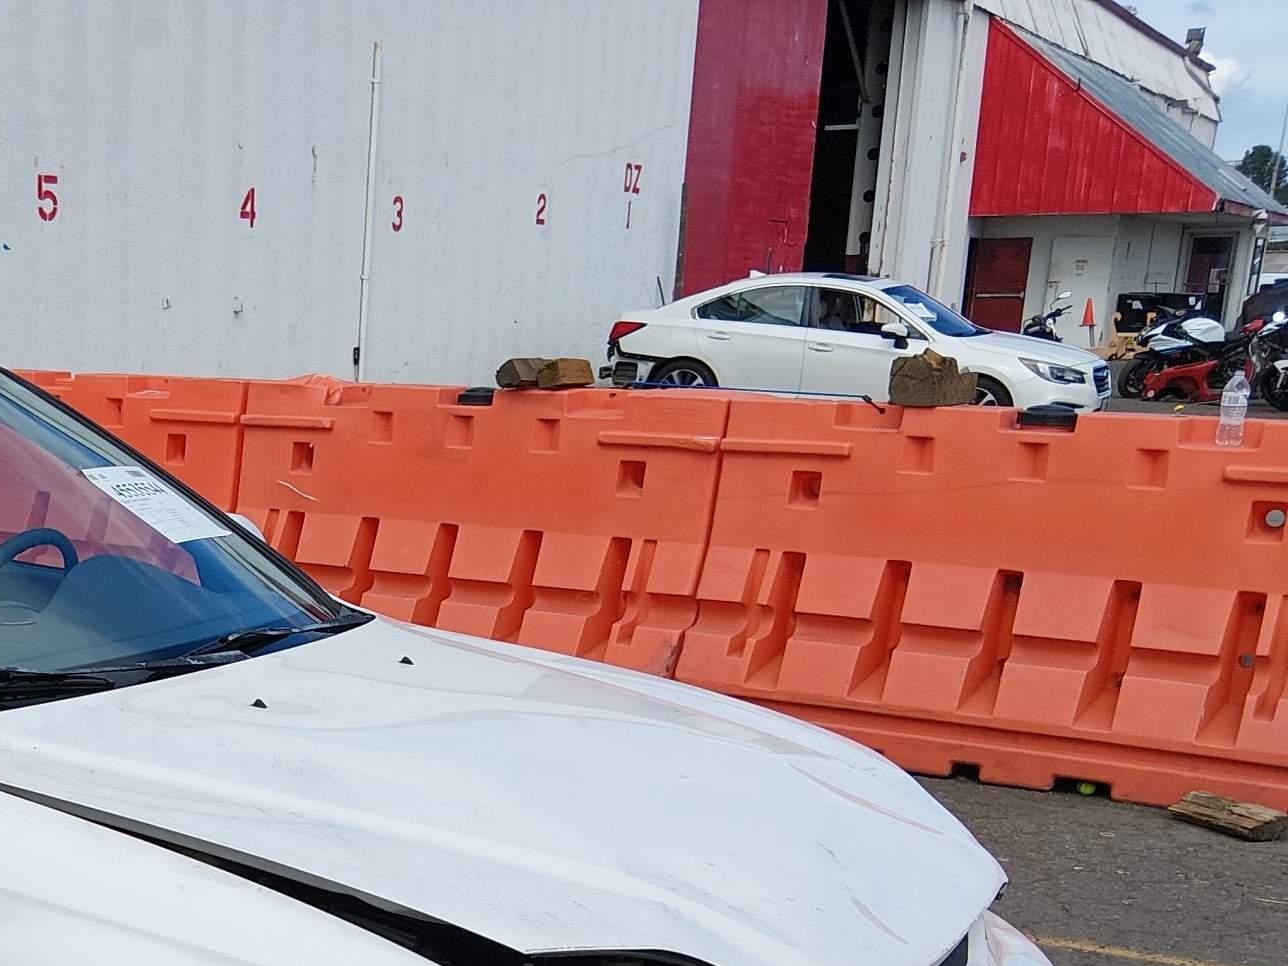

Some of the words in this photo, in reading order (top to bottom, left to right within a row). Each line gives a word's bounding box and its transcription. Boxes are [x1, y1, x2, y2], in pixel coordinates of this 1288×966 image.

[37, 174, 58, 222] 5
[239, 187, 256, 228] 4
[391, 195, 404, 232] 3
[535, 193, 547, 225] 2
